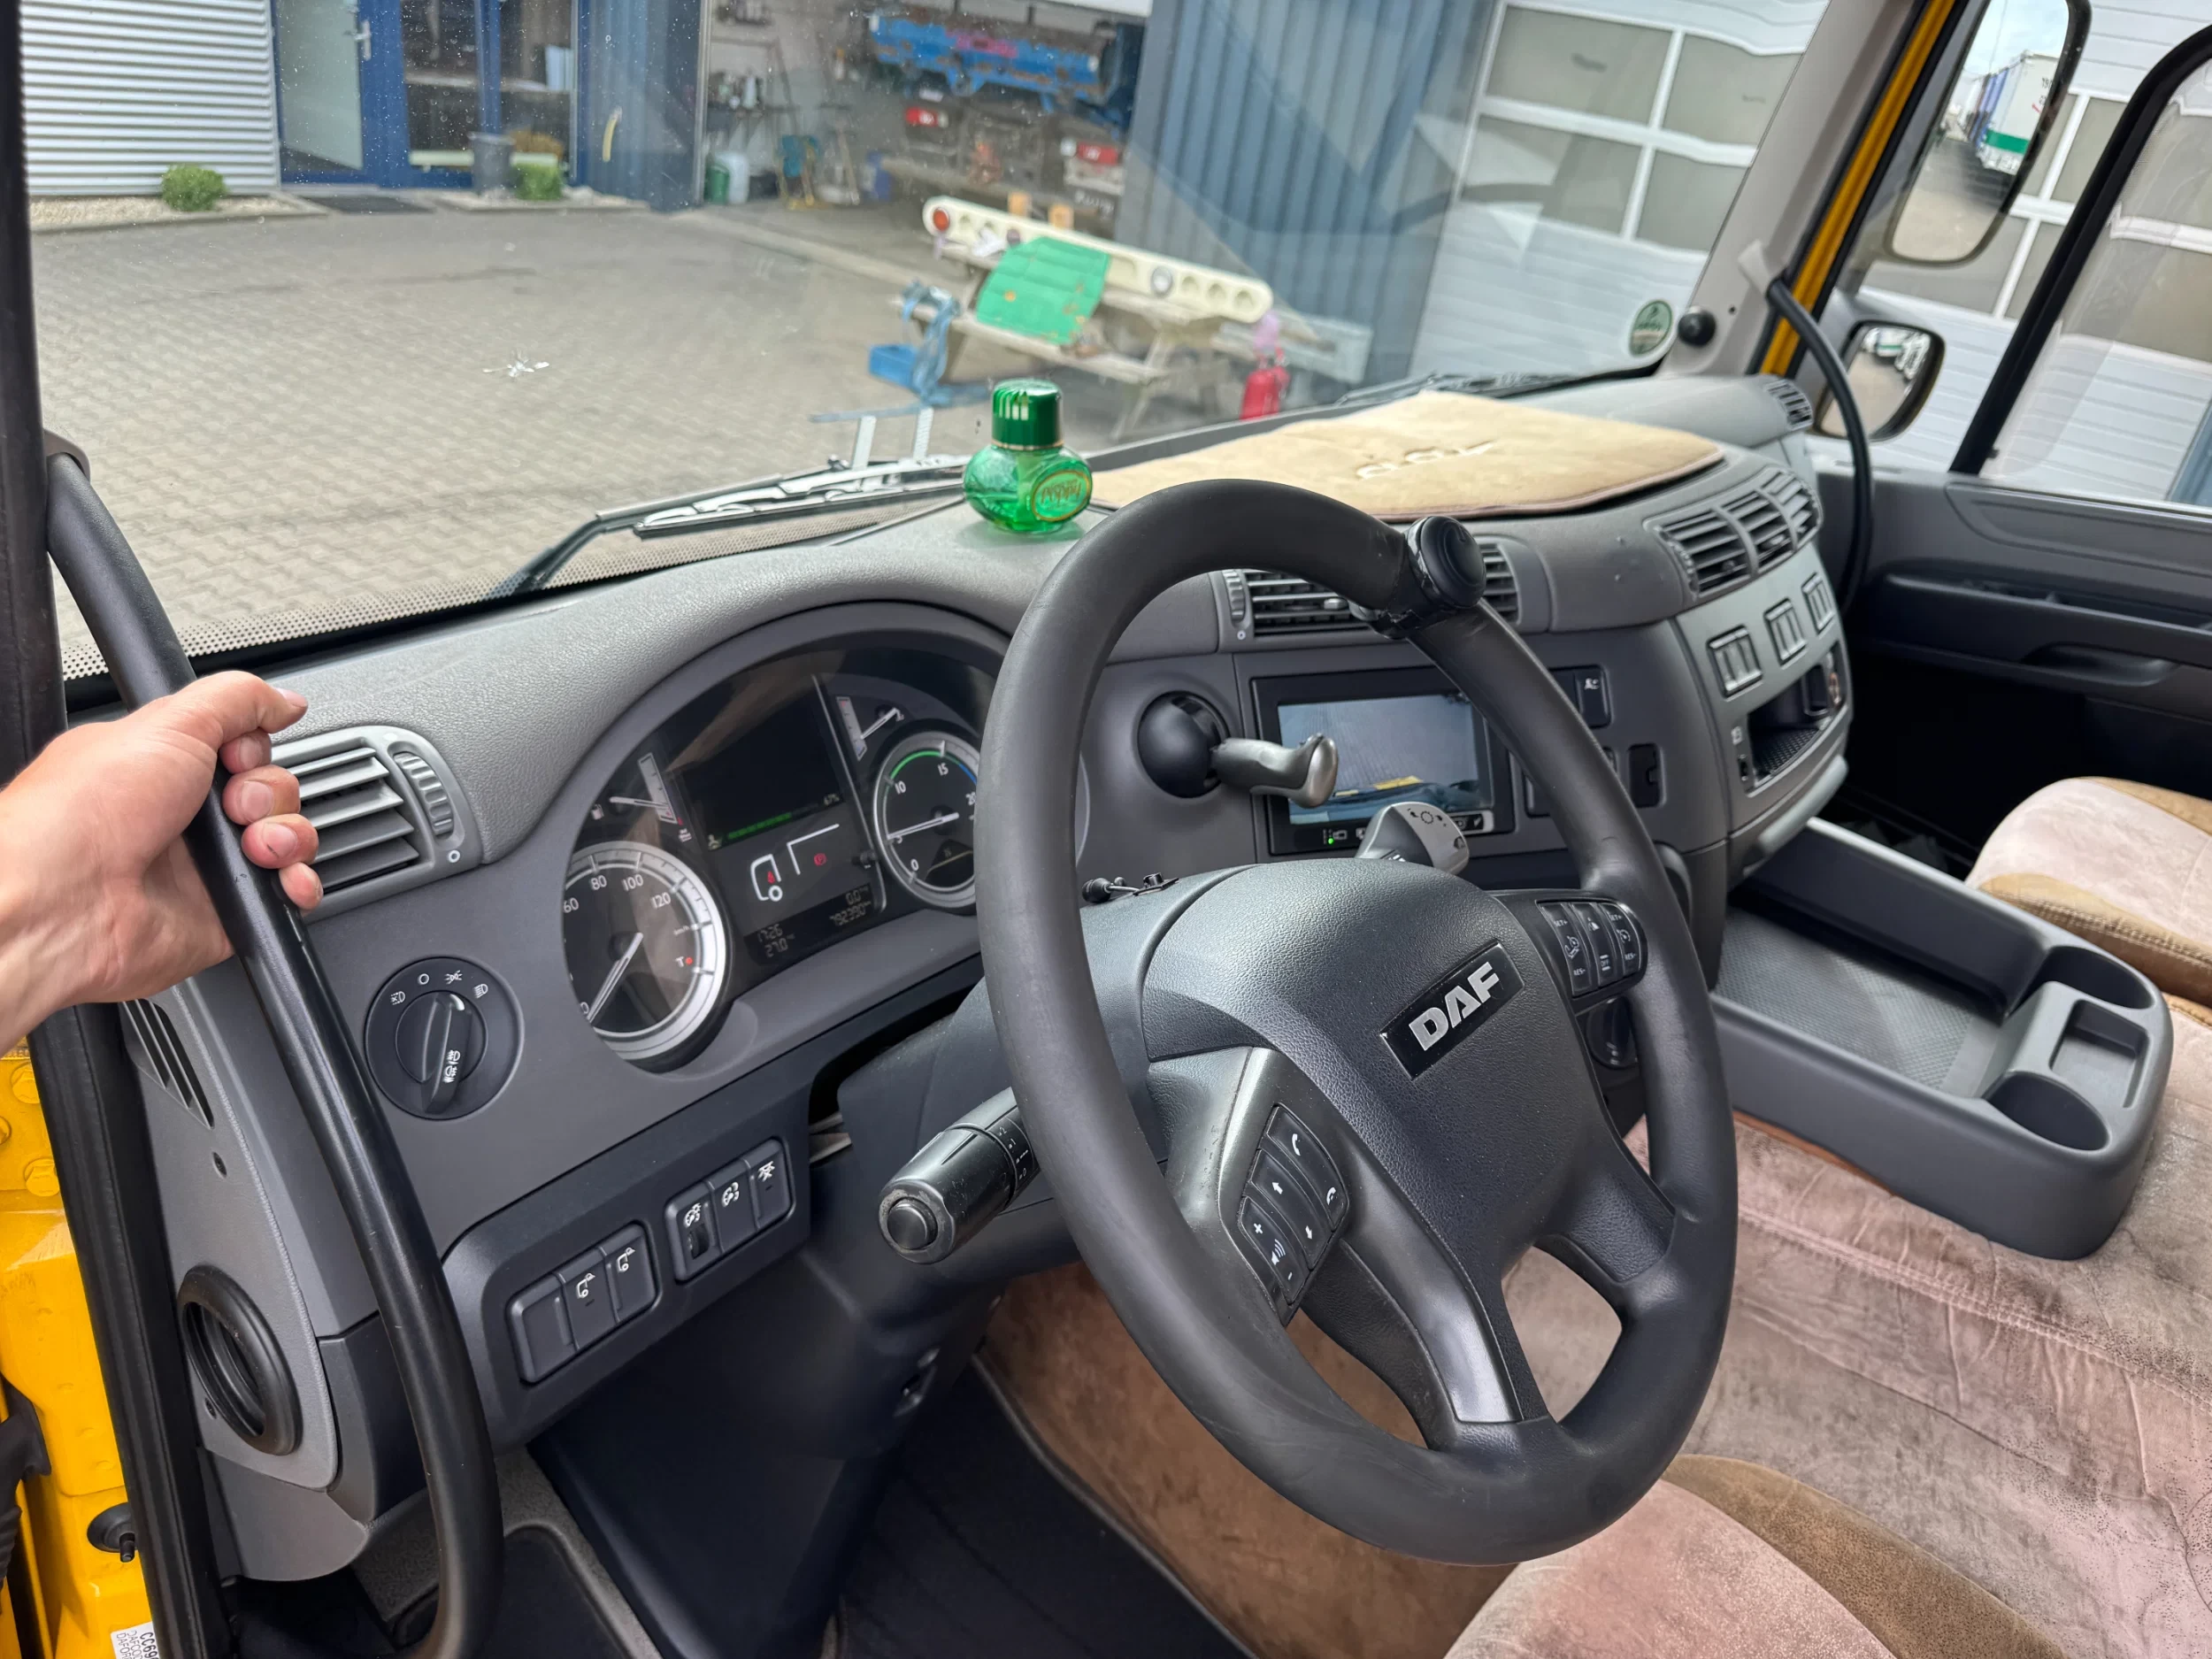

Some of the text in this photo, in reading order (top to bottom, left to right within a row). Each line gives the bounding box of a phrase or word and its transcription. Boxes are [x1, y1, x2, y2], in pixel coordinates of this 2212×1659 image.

[937, 763, 949, 776] 15
[895, 780, 907, 795] 10
[910, 858, 919, 872] 0
[589, 875, 608, 890] 80
[623, 873, 644, 892] 100
[563, 897, 580, 914] 60
[651, 892, 672, 909] 120
[1409, 961, 1500, 1051] DAF
[116, 1632, 133, 1659] DAFOR
[140, 1632, 159, 1659] CC69
